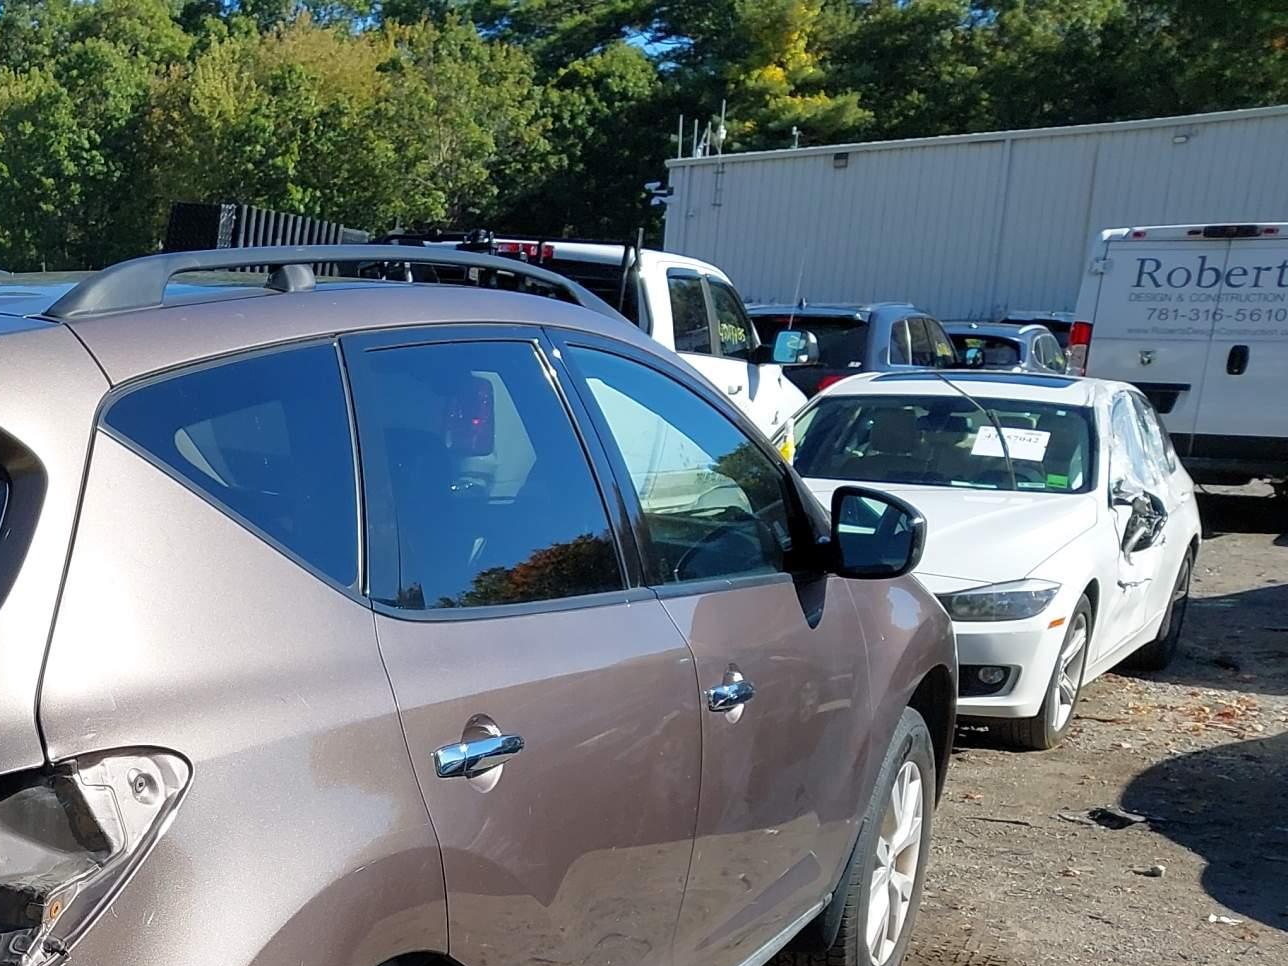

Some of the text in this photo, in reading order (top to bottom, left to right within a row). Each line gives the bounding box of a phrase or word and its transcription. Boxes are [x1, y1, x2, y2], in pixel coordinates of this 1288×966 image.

[1128, 292, 1286, 304] DESIGN & CONSTRUCTION
[1146, 307, 1288, 322] 781-316-5610
